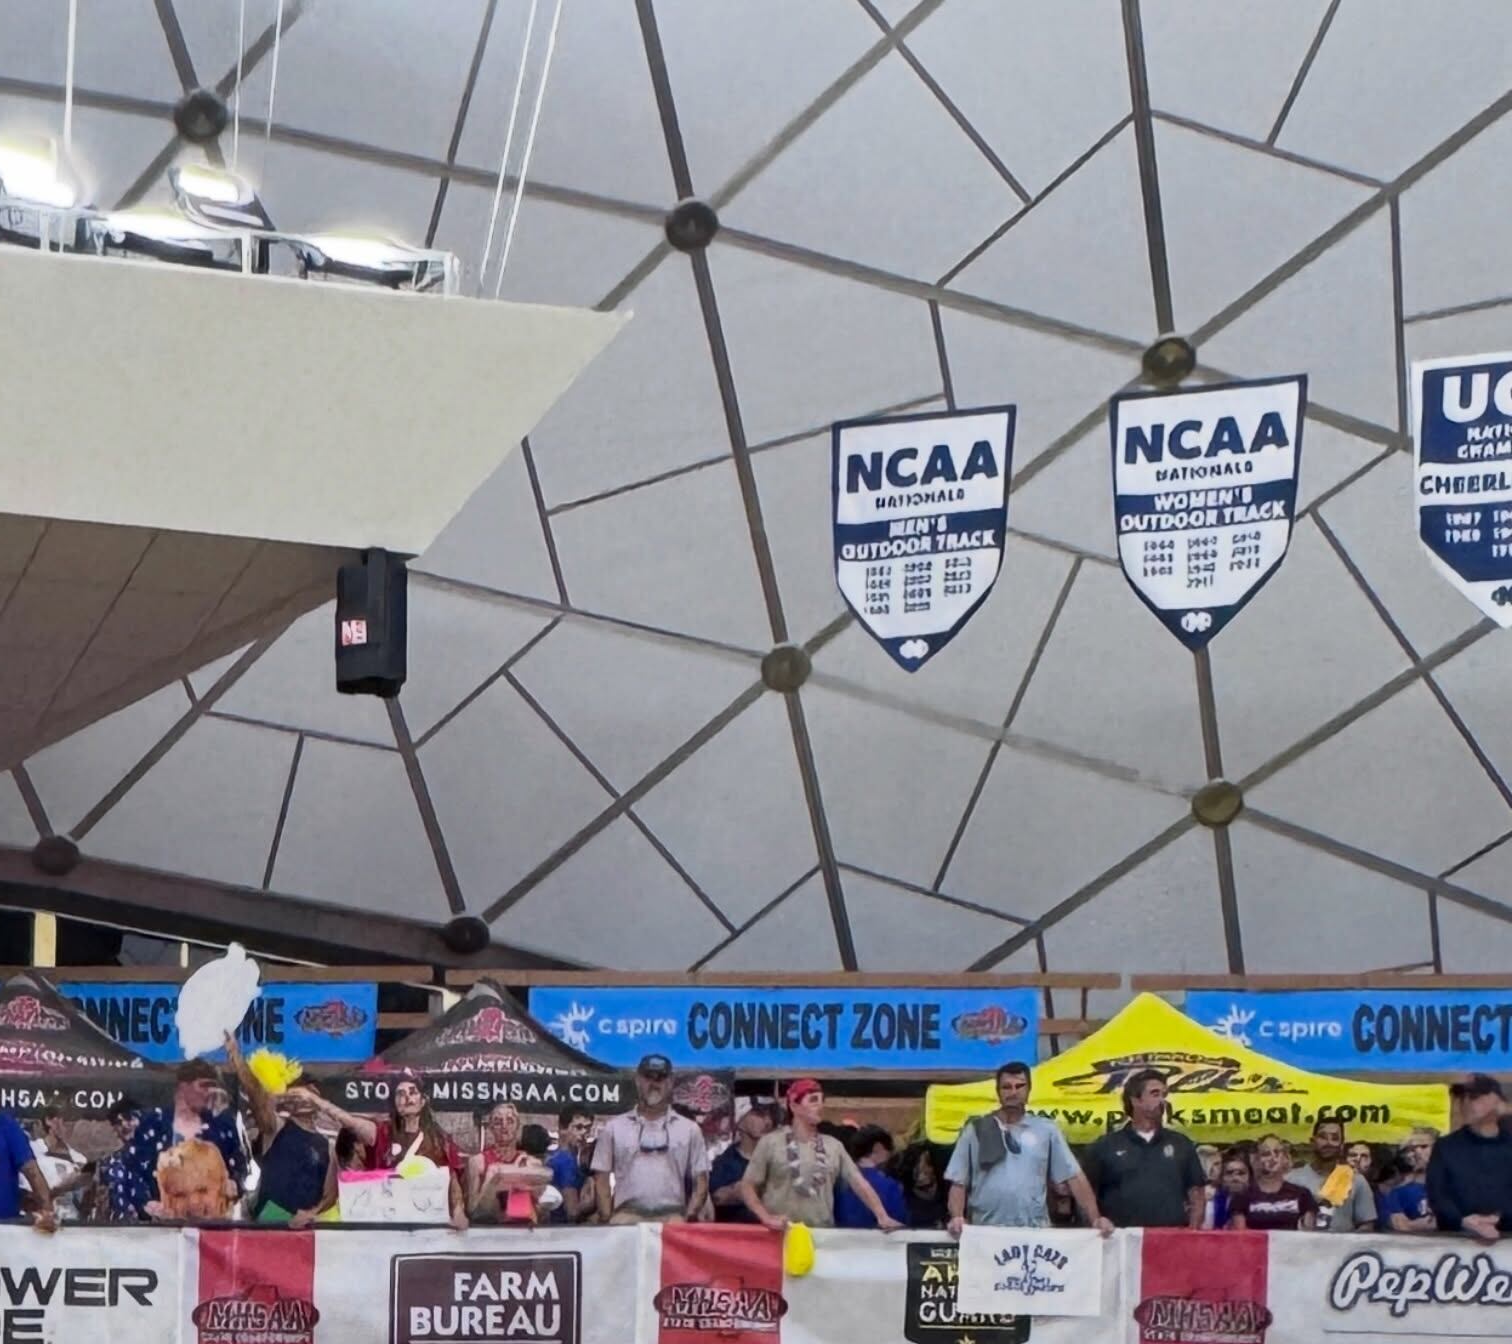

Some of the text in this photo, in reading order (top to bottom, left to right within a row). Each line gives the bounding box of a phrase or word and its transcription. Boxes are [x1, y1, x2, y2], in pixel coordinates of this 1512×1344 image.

[1124, 411, 1290, 465] NCAA
[846, 439, 999, 494] NCAA
[1120, 500, 1287, 532] OUTDOOR TRACK
[841, 529, 997, 560] OUTDOOR TRACK
[616, 1015, 677, 1039] spire
[688, 1001, 844, 1051] CONNECT
[850, 1003, 941, 1050] ZONE
[1278, 1019, 1342, 1044] spire
[453, 1271, 559, 1301] FARM
[207, 1300, 306, 1331] MHSAA
[409, 1304, 561, 1337] BUREAU
